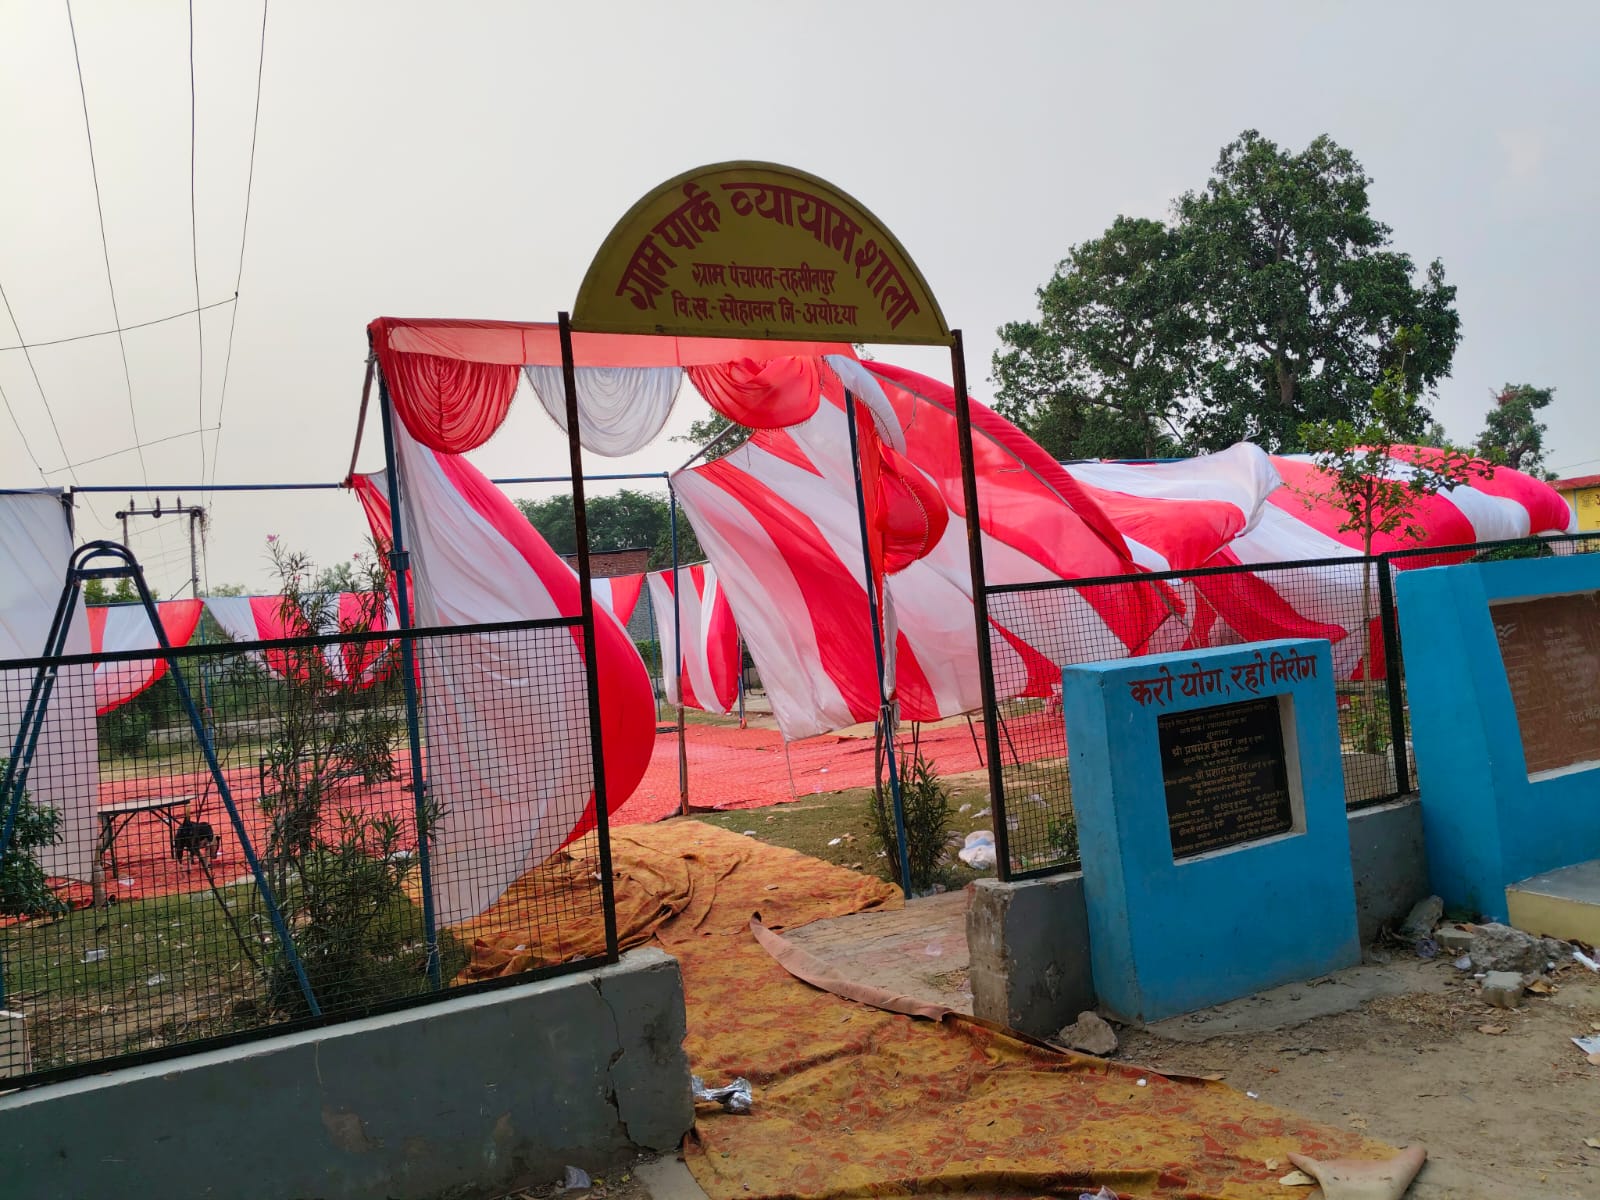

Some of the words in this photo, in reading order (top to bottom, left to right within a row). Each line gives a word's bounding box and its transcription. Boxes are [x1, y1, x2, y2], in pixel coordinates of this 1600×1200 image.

[616, 235, 677, 310] ग्राम
[652, 182, 720, 249] पार्क
[720, 183, 862, 263] व्यायाम
[855, 239, 920, 330] शाला
[692, 263, 726, 287] ग्राम
[1129, 664, 1175, 706] करो
[1179, 662, 1231, 697] योग,
[1230, 652, 1268, 694] रहो
[1270, 647, 1317, 684] निरोग
